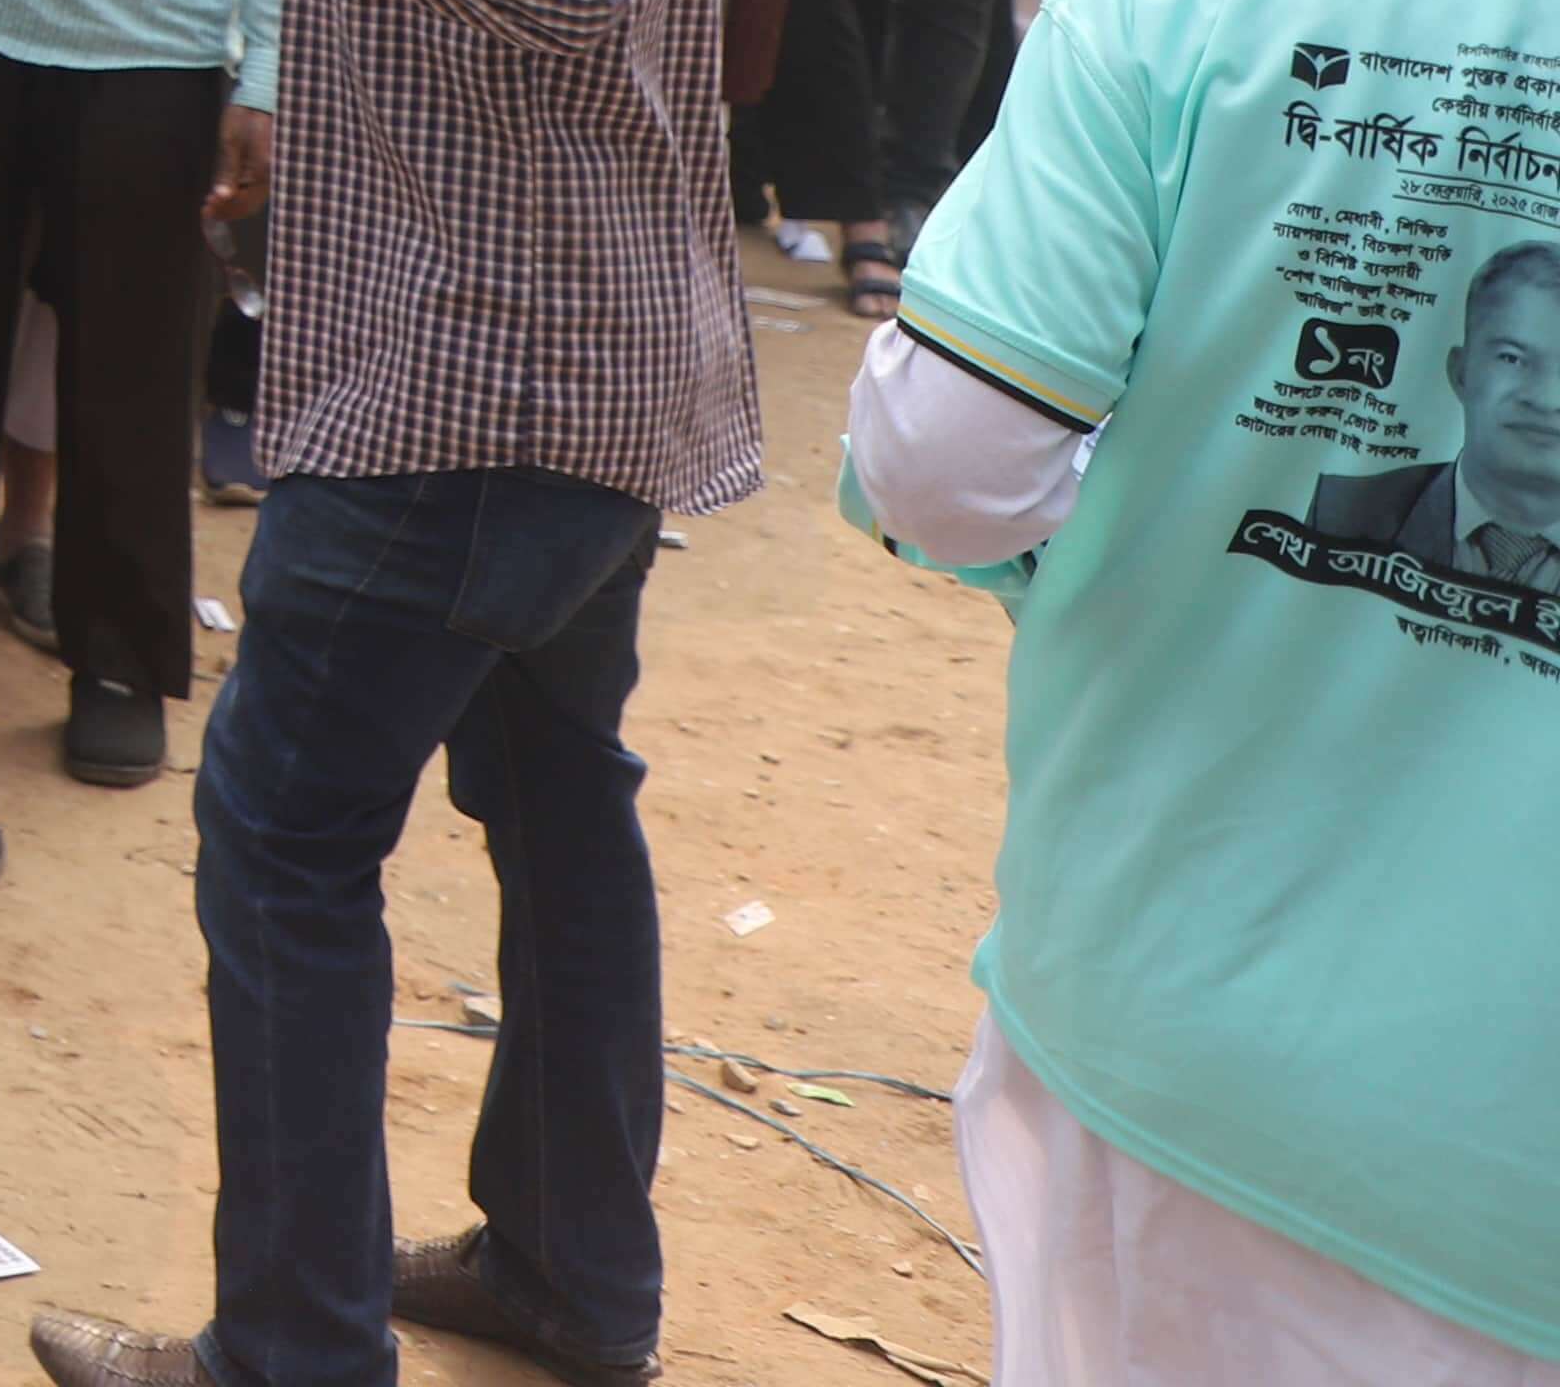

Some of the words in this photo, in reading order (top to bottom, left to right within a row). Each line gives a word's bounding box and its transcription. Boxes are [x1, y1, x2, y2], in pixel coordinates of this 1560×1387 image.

[1360, 51, 1453, 83] বাংলাদেশ
[1462, 66, 1507, 89] পুস্তক
[1432, 94, 1490, 120] কেন্দ্রীয়
[1283, 100, 1443, 166] দ্বি-বার্ষিক
[1400, 178, 1422, 195] ২৮
[1492, 192, 1528, 211] ২০২৫
[1397, 216, 1448, 239] শিক্ষিত
[1297, 249, 1311, 262] ও
[1315, 247, 1358, 271] বিশিষ্ট
[1363, 234, 1413, 258] বিচক্ষণ
[1320, 274, 1382, 300] আজিজুল
[1386, 282, 1437, 307] ইসলাম
[1358, 302, 1385, 320] ভাই
[1308, 325, 1341, 375] ১
[1346, 347, 1385, 386] নং
[1326, 385, 1361, 403] ভোট
[1365, 393, 1398, 417] দিয়ে
[1254, 396, 1301, 420] জয়যুক্ত
[1384, 422, 1408, 439] চাই
[1366, 443, 1421, 460] সকলের
[1243, 520, 1316, 568] শেখ
[1327, 549, 1522, 624] আজিজুল
